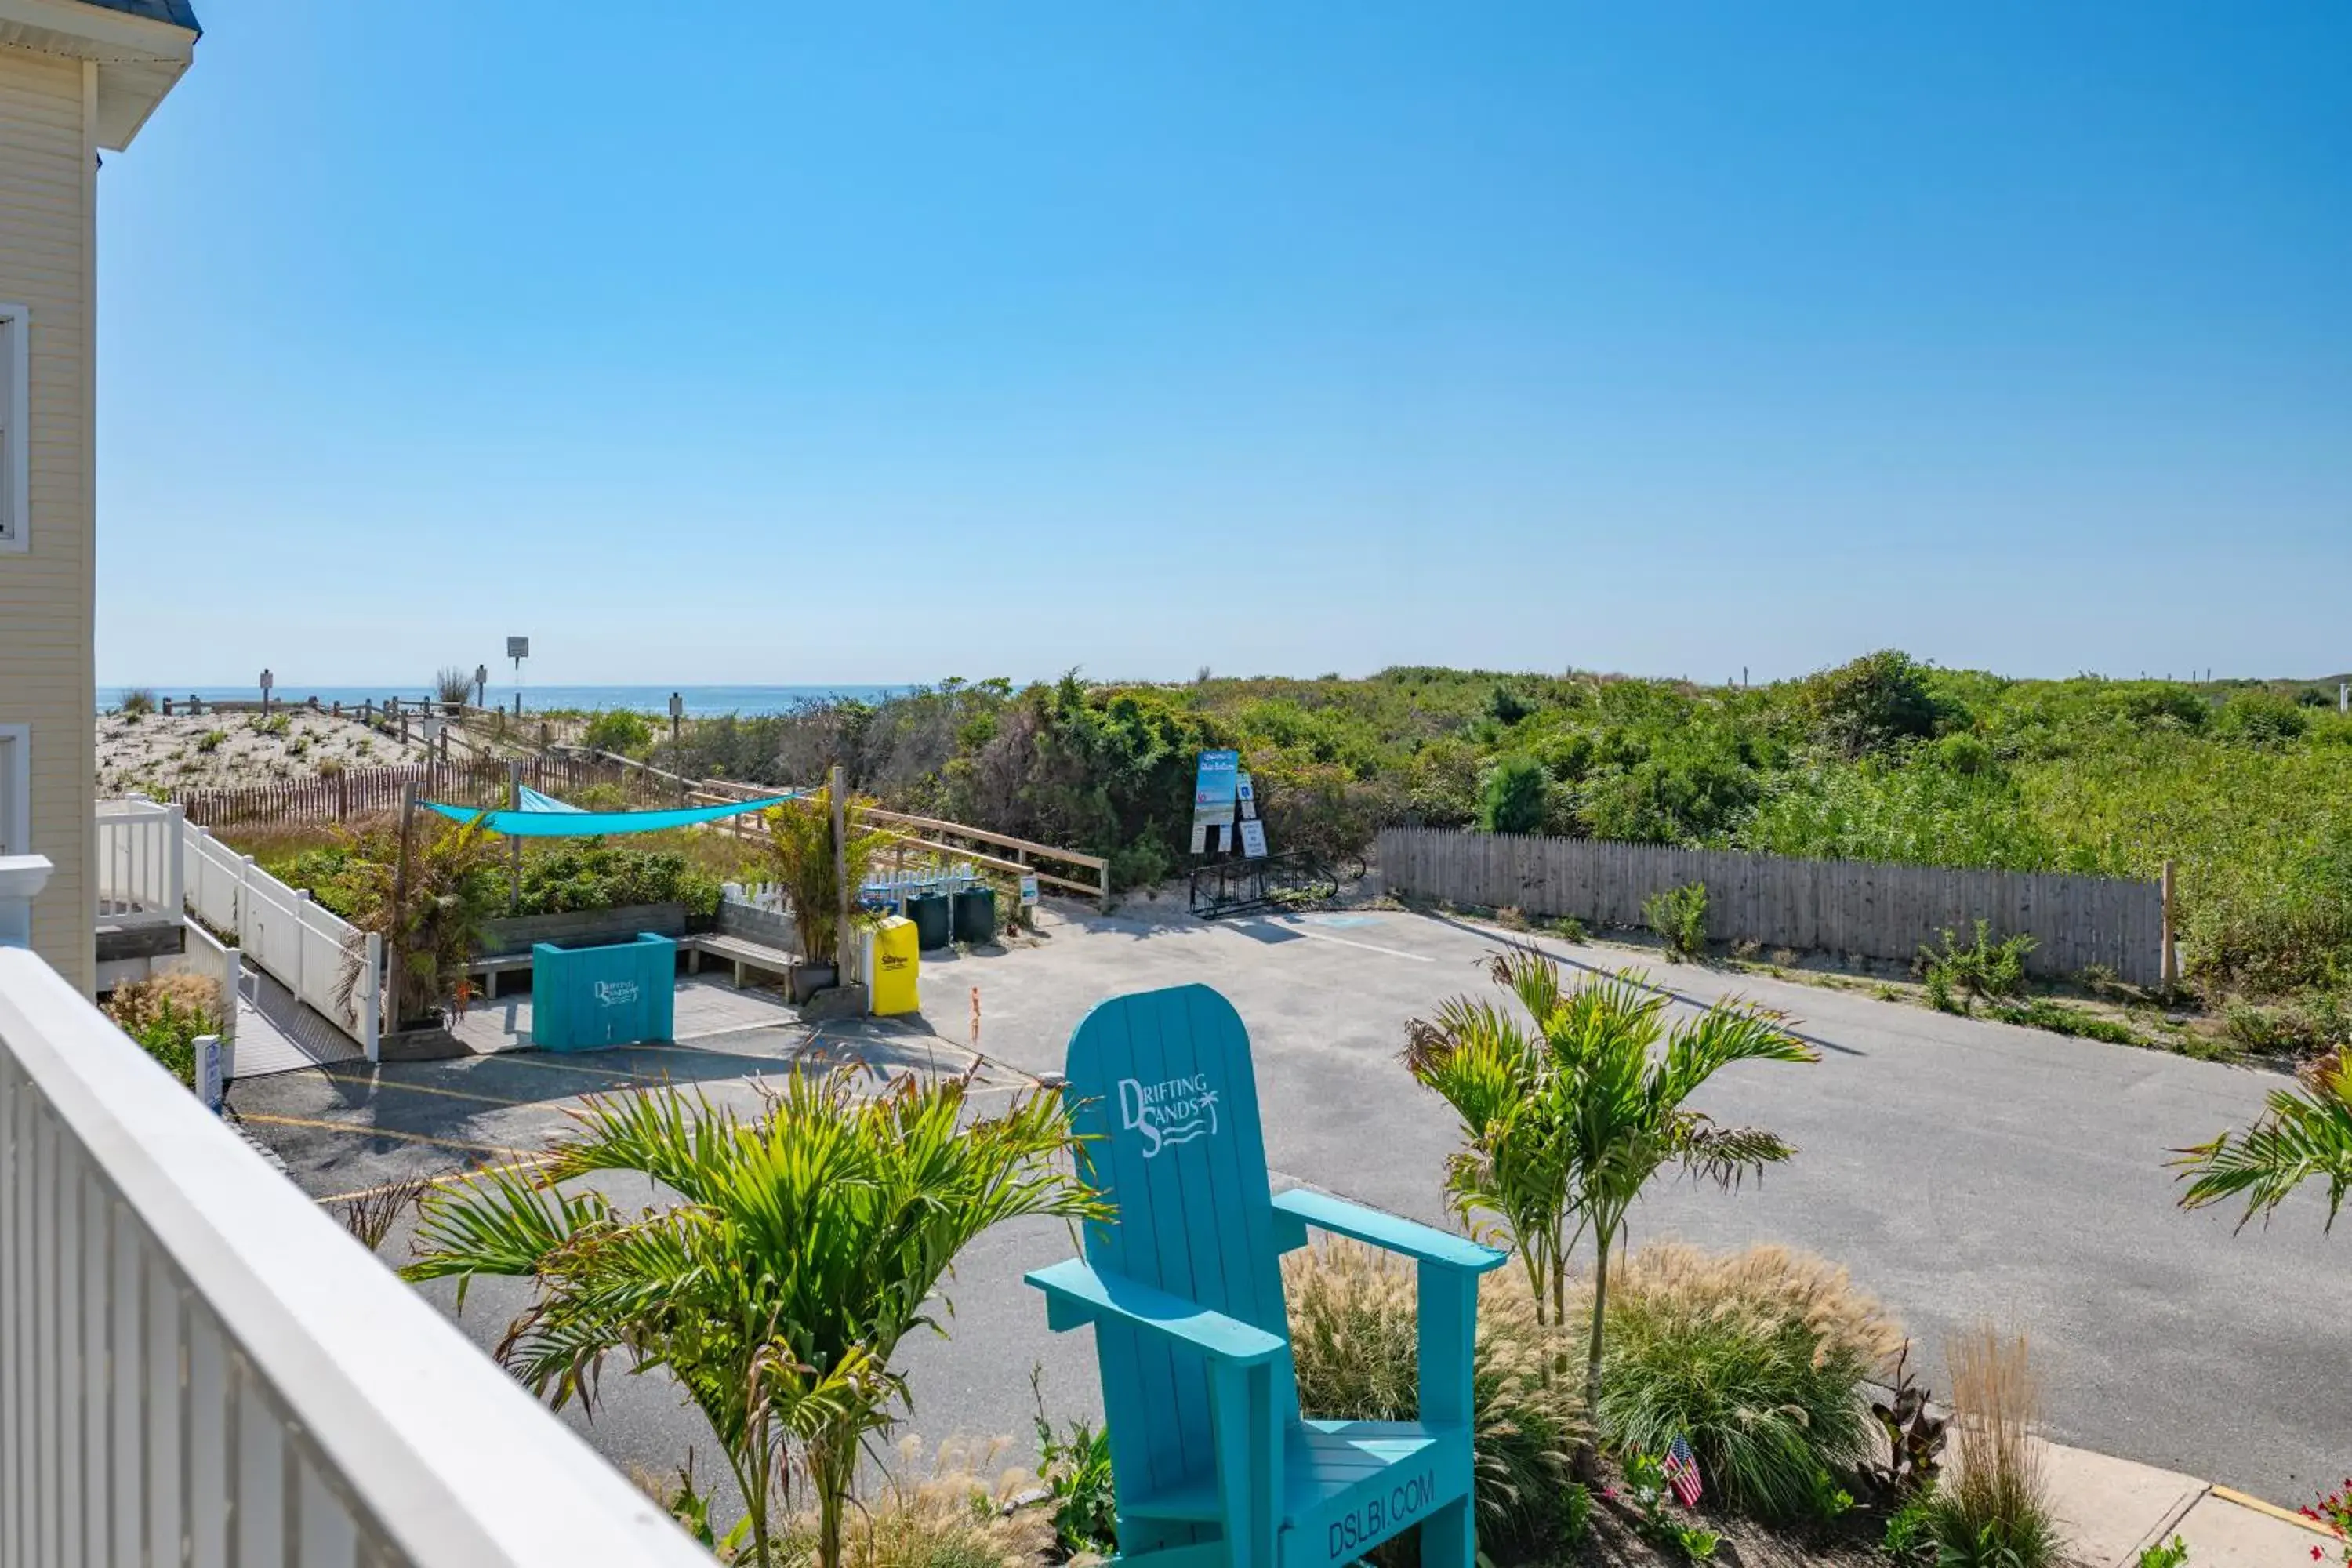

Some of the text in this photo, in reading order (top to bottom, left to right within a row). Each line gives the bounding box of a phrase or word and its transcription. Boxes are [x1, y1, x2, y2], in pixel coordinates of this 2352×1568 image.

[1118, 1073, 1207, 1129] DRIFTING
[1139, 1098, 1200, 1158] SANDS
[1329, 1468, 1435, 1559] DSLBI.COM
